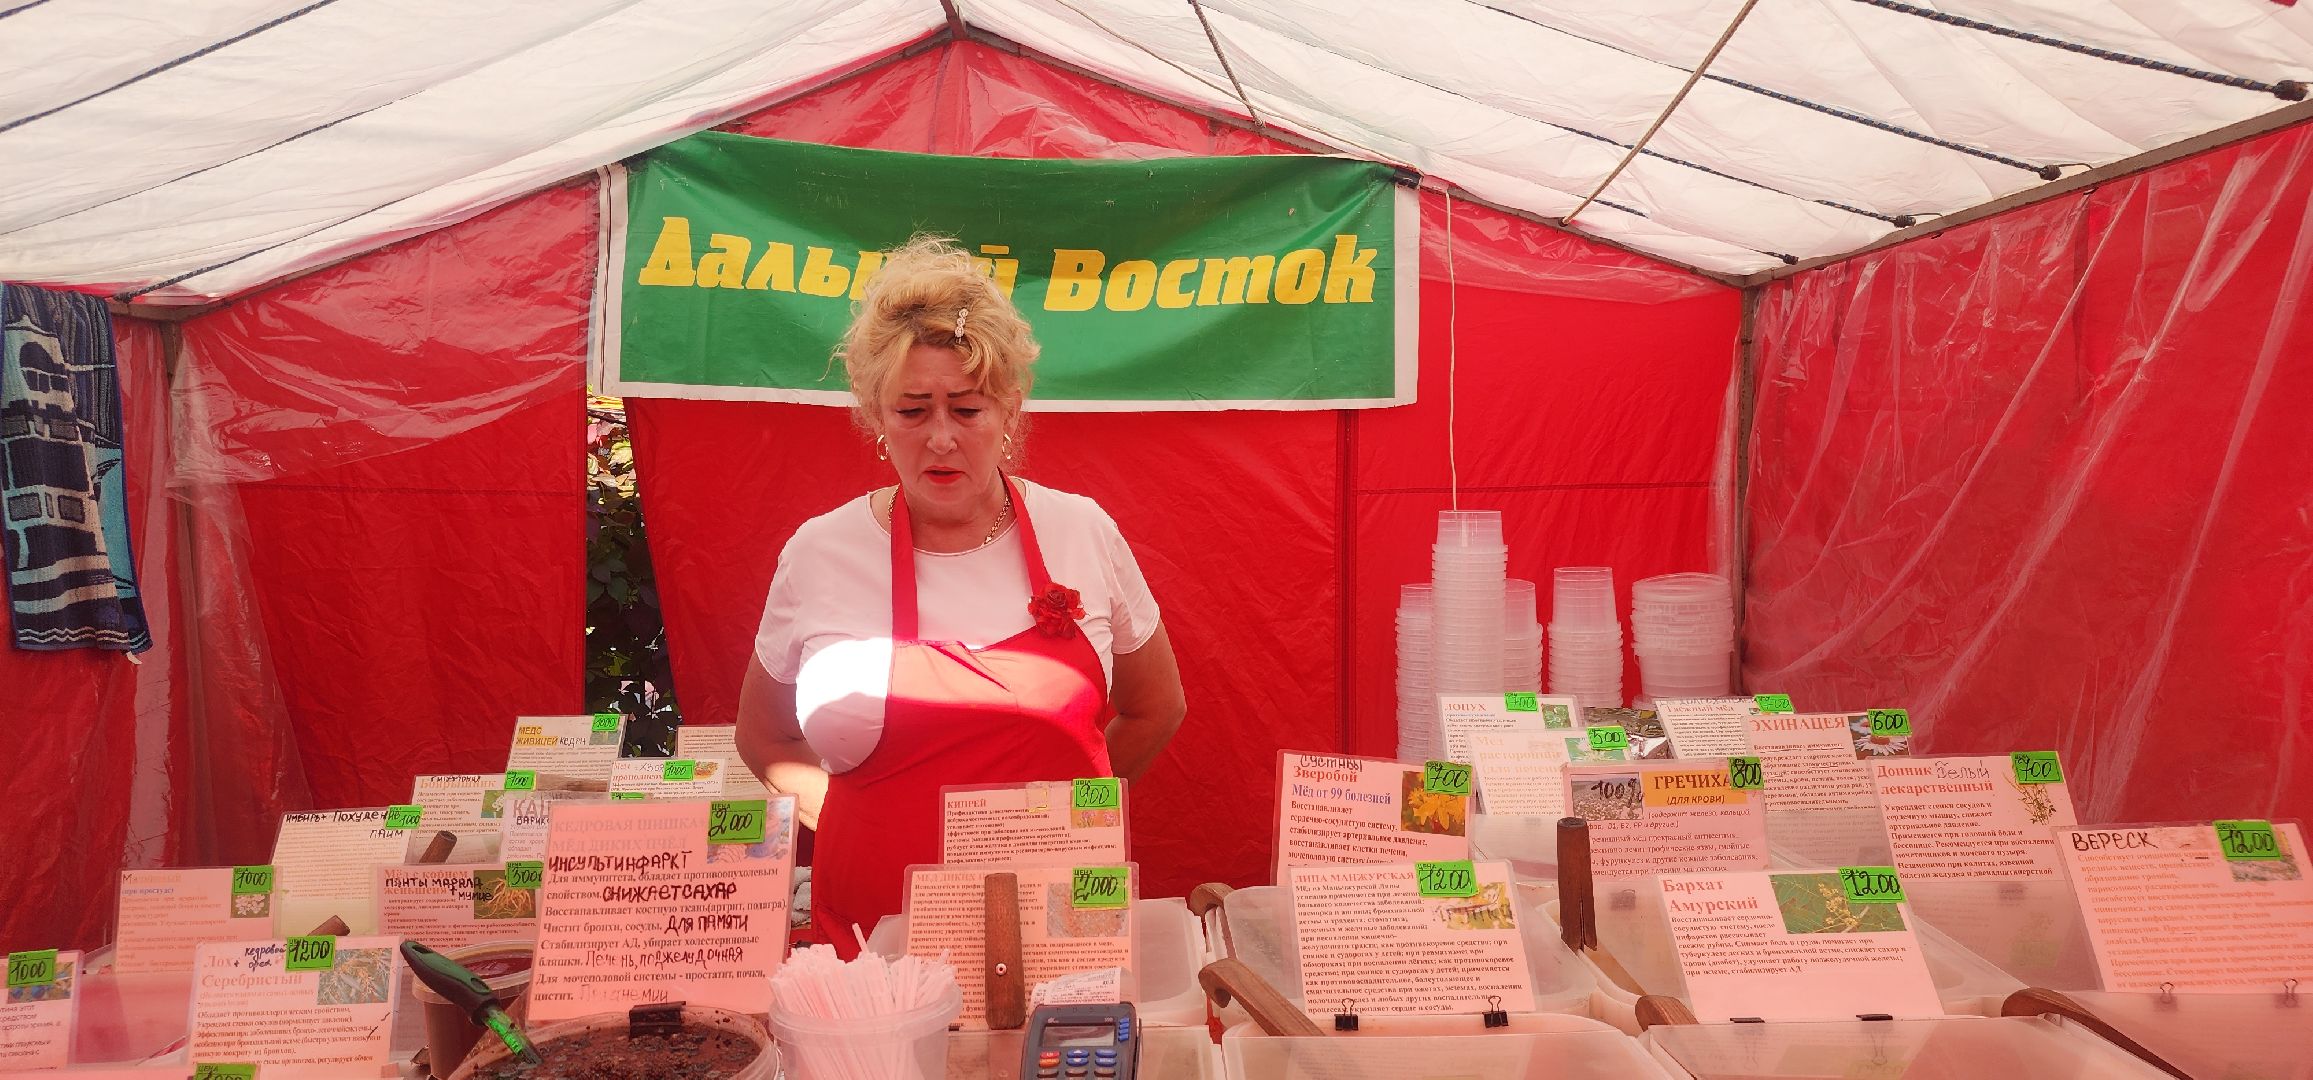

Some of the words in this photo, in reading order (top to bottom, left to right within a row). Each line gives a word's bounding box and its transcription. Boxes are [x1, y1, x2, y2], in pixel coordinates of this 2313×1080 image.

[1044, 234, 1379, 313] Восток
[1445, 703, 1486, 711] ЛОПУХ
[1750, 716, 1846, 732] ЭХИНАЦЕЯ
[1873, 710, 1903, 731] 600
[1591, 731, 1620, 744] 500
[1294, 765, 1358, 783] Зверобой
[1427, 765, 1468, 789] 700
[1733, 759, 1762, 788] 800
[1878, 765, 1932, 778] Донник
[2020, 757, 2052, 781] 700
[1654, 773, 1732, 789] ГРЕЧИХА
[1881, 781, 1994, 796] лекарственный
[1292, 784, 1314, 798] Мёд
[1317, 790, 1328, 798] от
[1331, 788, 1342, 799] 99
[1345, 788, 1391, 804] болезней
[1667, 796, 1689, 805] (ДЛЯ
[1691, 795, 1725, 805] КРОВИ)
[947, 799, 987, 809] КИПРЕЙ
[1885, 804, 1926, 812] Укрепляет
[554, 819, 633, 833] КЕДРОВАЯ
[709, 810, 753, 837] 2000
[1945, 831, 1960, 839] при
[2222, 829, 2275, 855] 1200
[548, 873, 569, 885] Для
[683, 868, 778, 882] противоопухолевым
[1295, 875, 1328, 883] ЛИПА
[1331, 872, 1414, 882] МАНЖУРСКАЯ
[1420, 869, 1472, 891] 1200
[1844, 869, 1900, 896] 1200
[547, 889, 602, 900] свойством.
[1663, 879, 1724, 895] Бархат
[546, 906, 634, 917] Восстанавливает
[636, 905, 678, 917] костную
[1669, 897, 1759, 914] Амурский
[544, 922, 581, 934] Чистит
[583, 921, 623, 935] бронхи,
[289, 940, 331, 962] 1200
[541, 938, 619, 952] Стабилизирует
[643, 937, 681, 951] убирает
[684, 936, 760, 948] холестериновые
[204, 955, 232, 969] Лох
[11, 960, 47, 982] 1000
[536, 973, 559, 985] Для
[563, 972, 632, 984] мочеполовой
[634, 972, 677, 982] системы
[685, 971, 734, 982] простатит,
[201, 973, 304, 989] Серебристый
